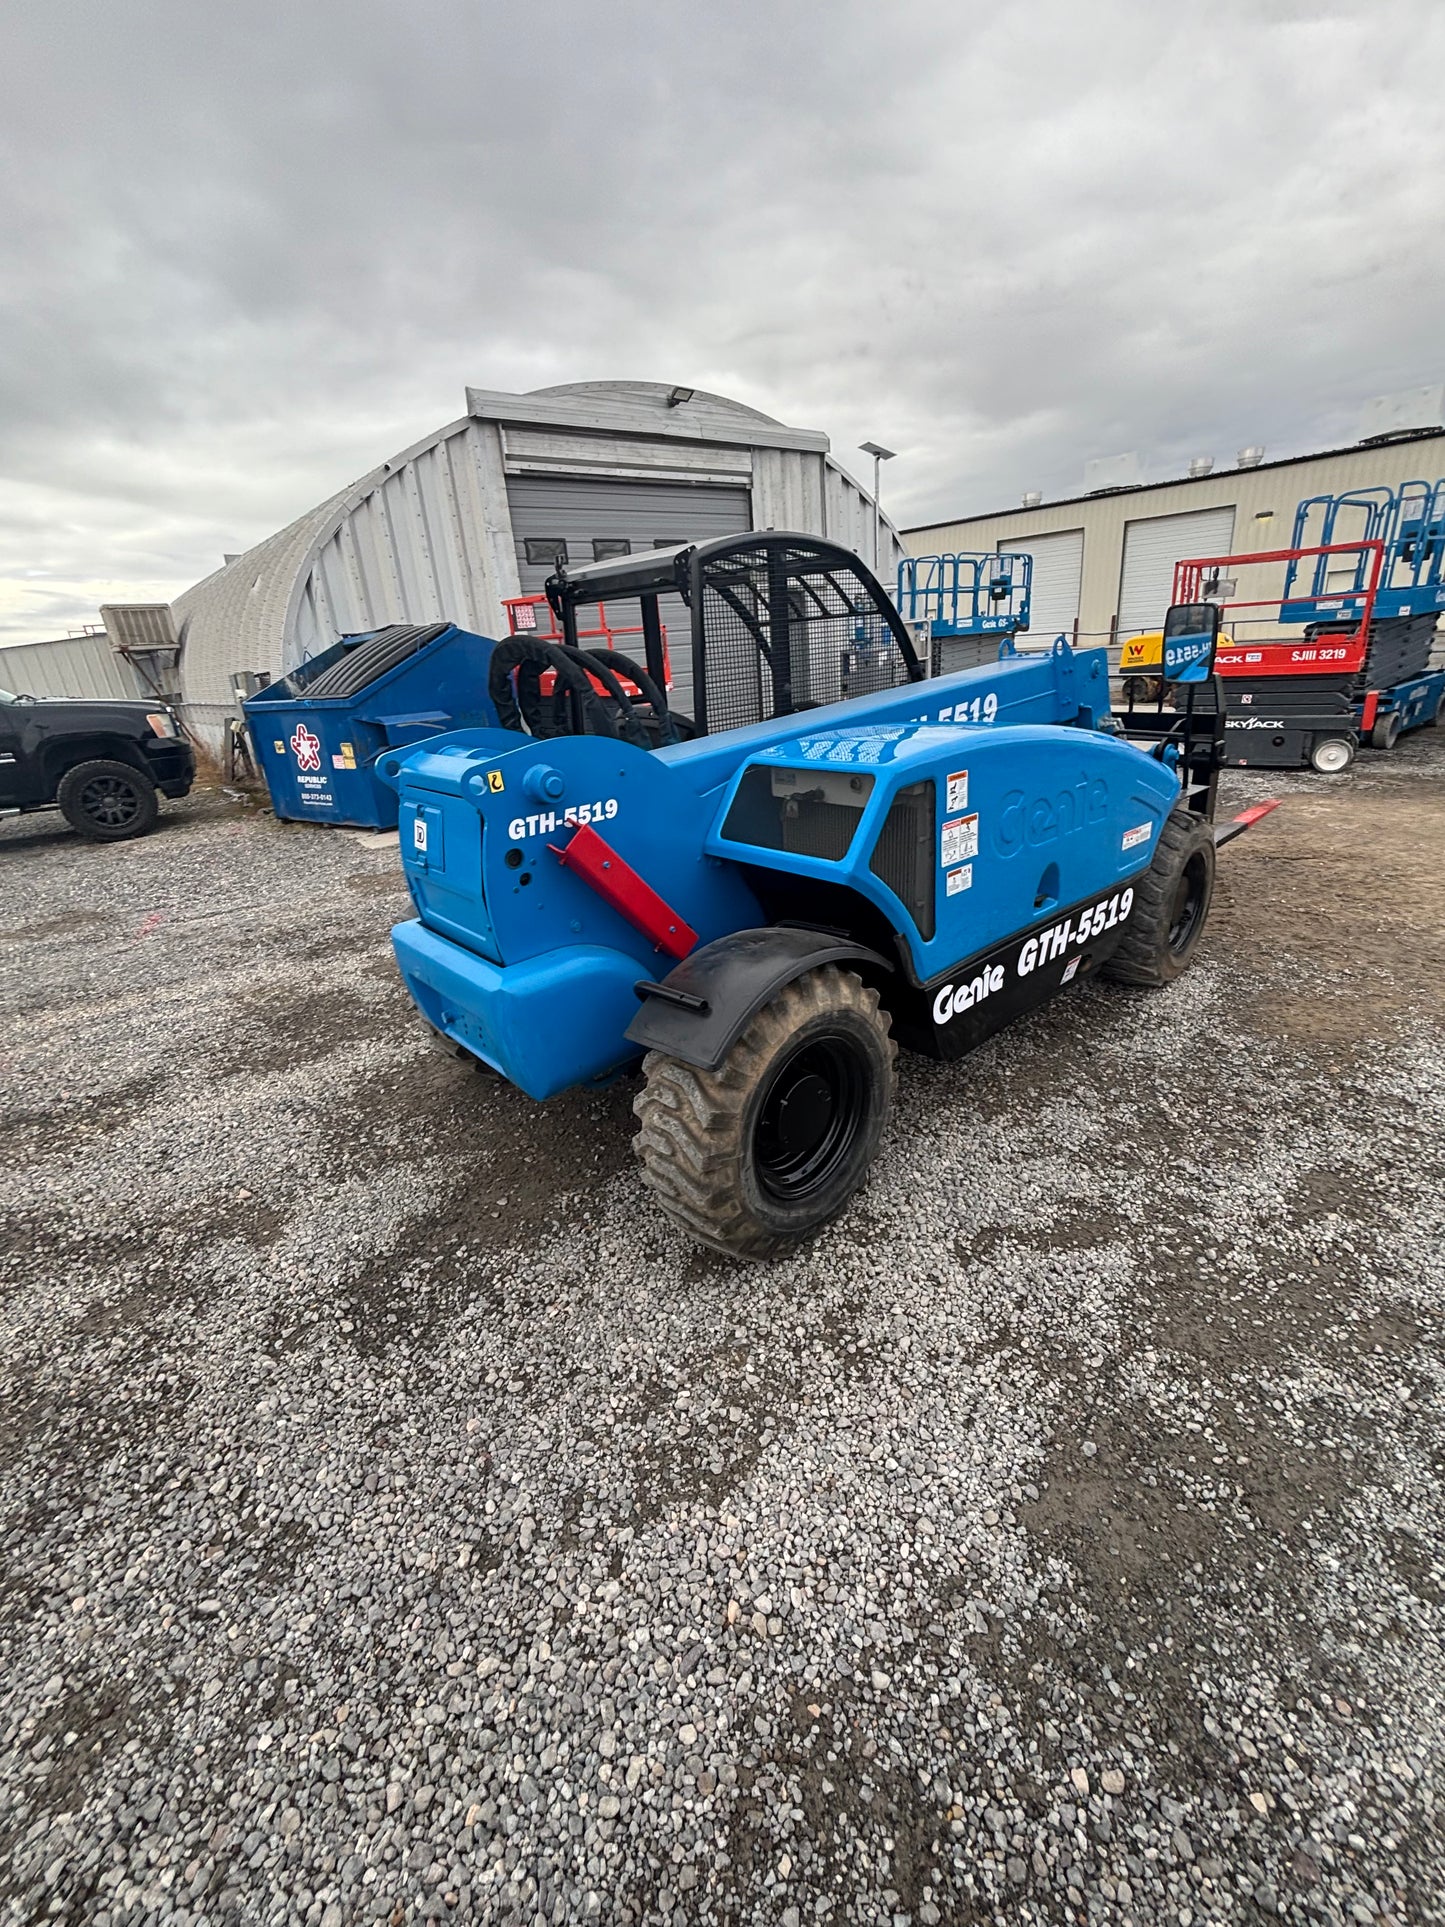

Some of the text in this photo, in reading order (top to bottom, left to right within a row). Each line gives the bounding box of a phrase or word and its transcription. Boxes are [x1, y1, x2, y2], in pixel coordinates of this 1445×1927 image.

[1318, 648, 1346, 660] 3219
[1224, 717, 1285, 730] SKYJACK
[297, 775, 328, 784] REPUBLIC
[508, 798, 618, 840] GTH-5519
[932, 887, 1134, 1025] Genie GTH-5519
